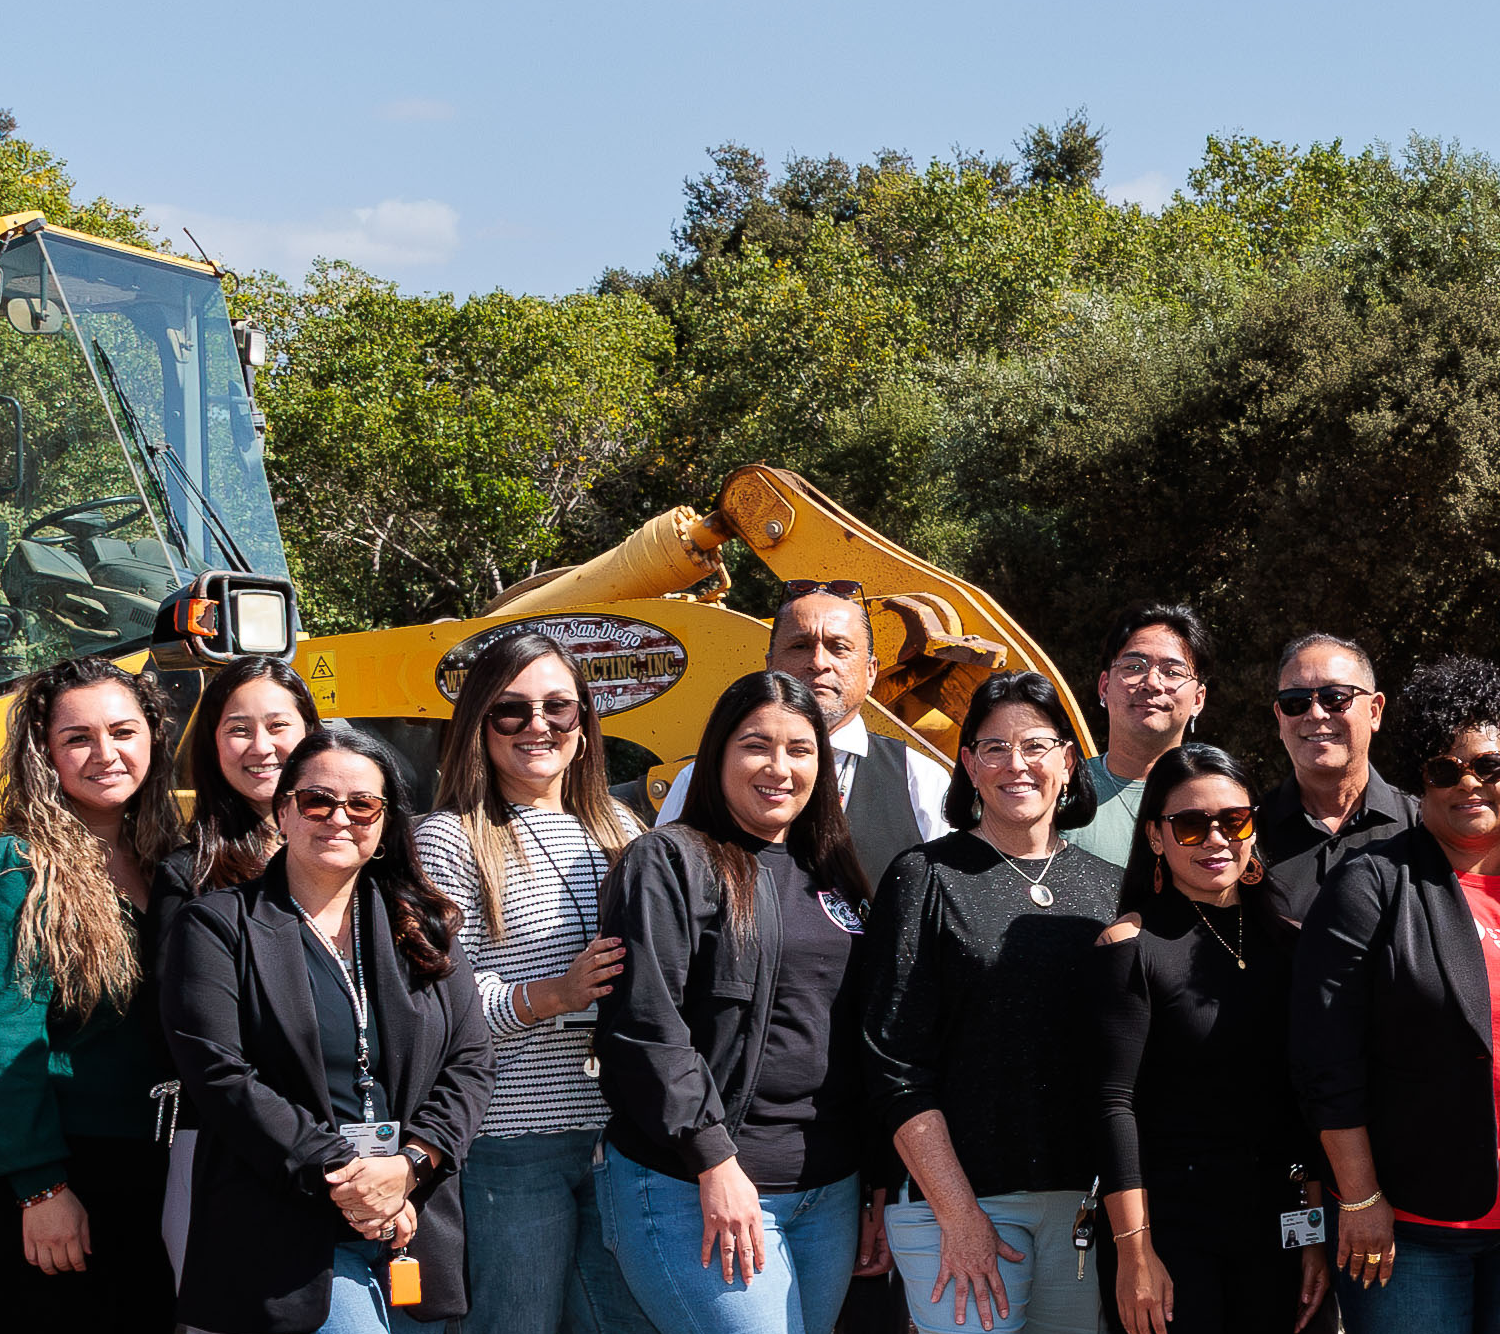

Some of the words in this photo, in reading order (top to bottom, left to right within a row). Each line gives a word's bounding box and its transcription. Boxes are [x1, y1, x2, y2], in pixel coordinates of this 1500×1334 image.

[568, 620, 597, 639] San
[599, 622, 641, 649] Diego
[647, 652, 682, 679] INC.
